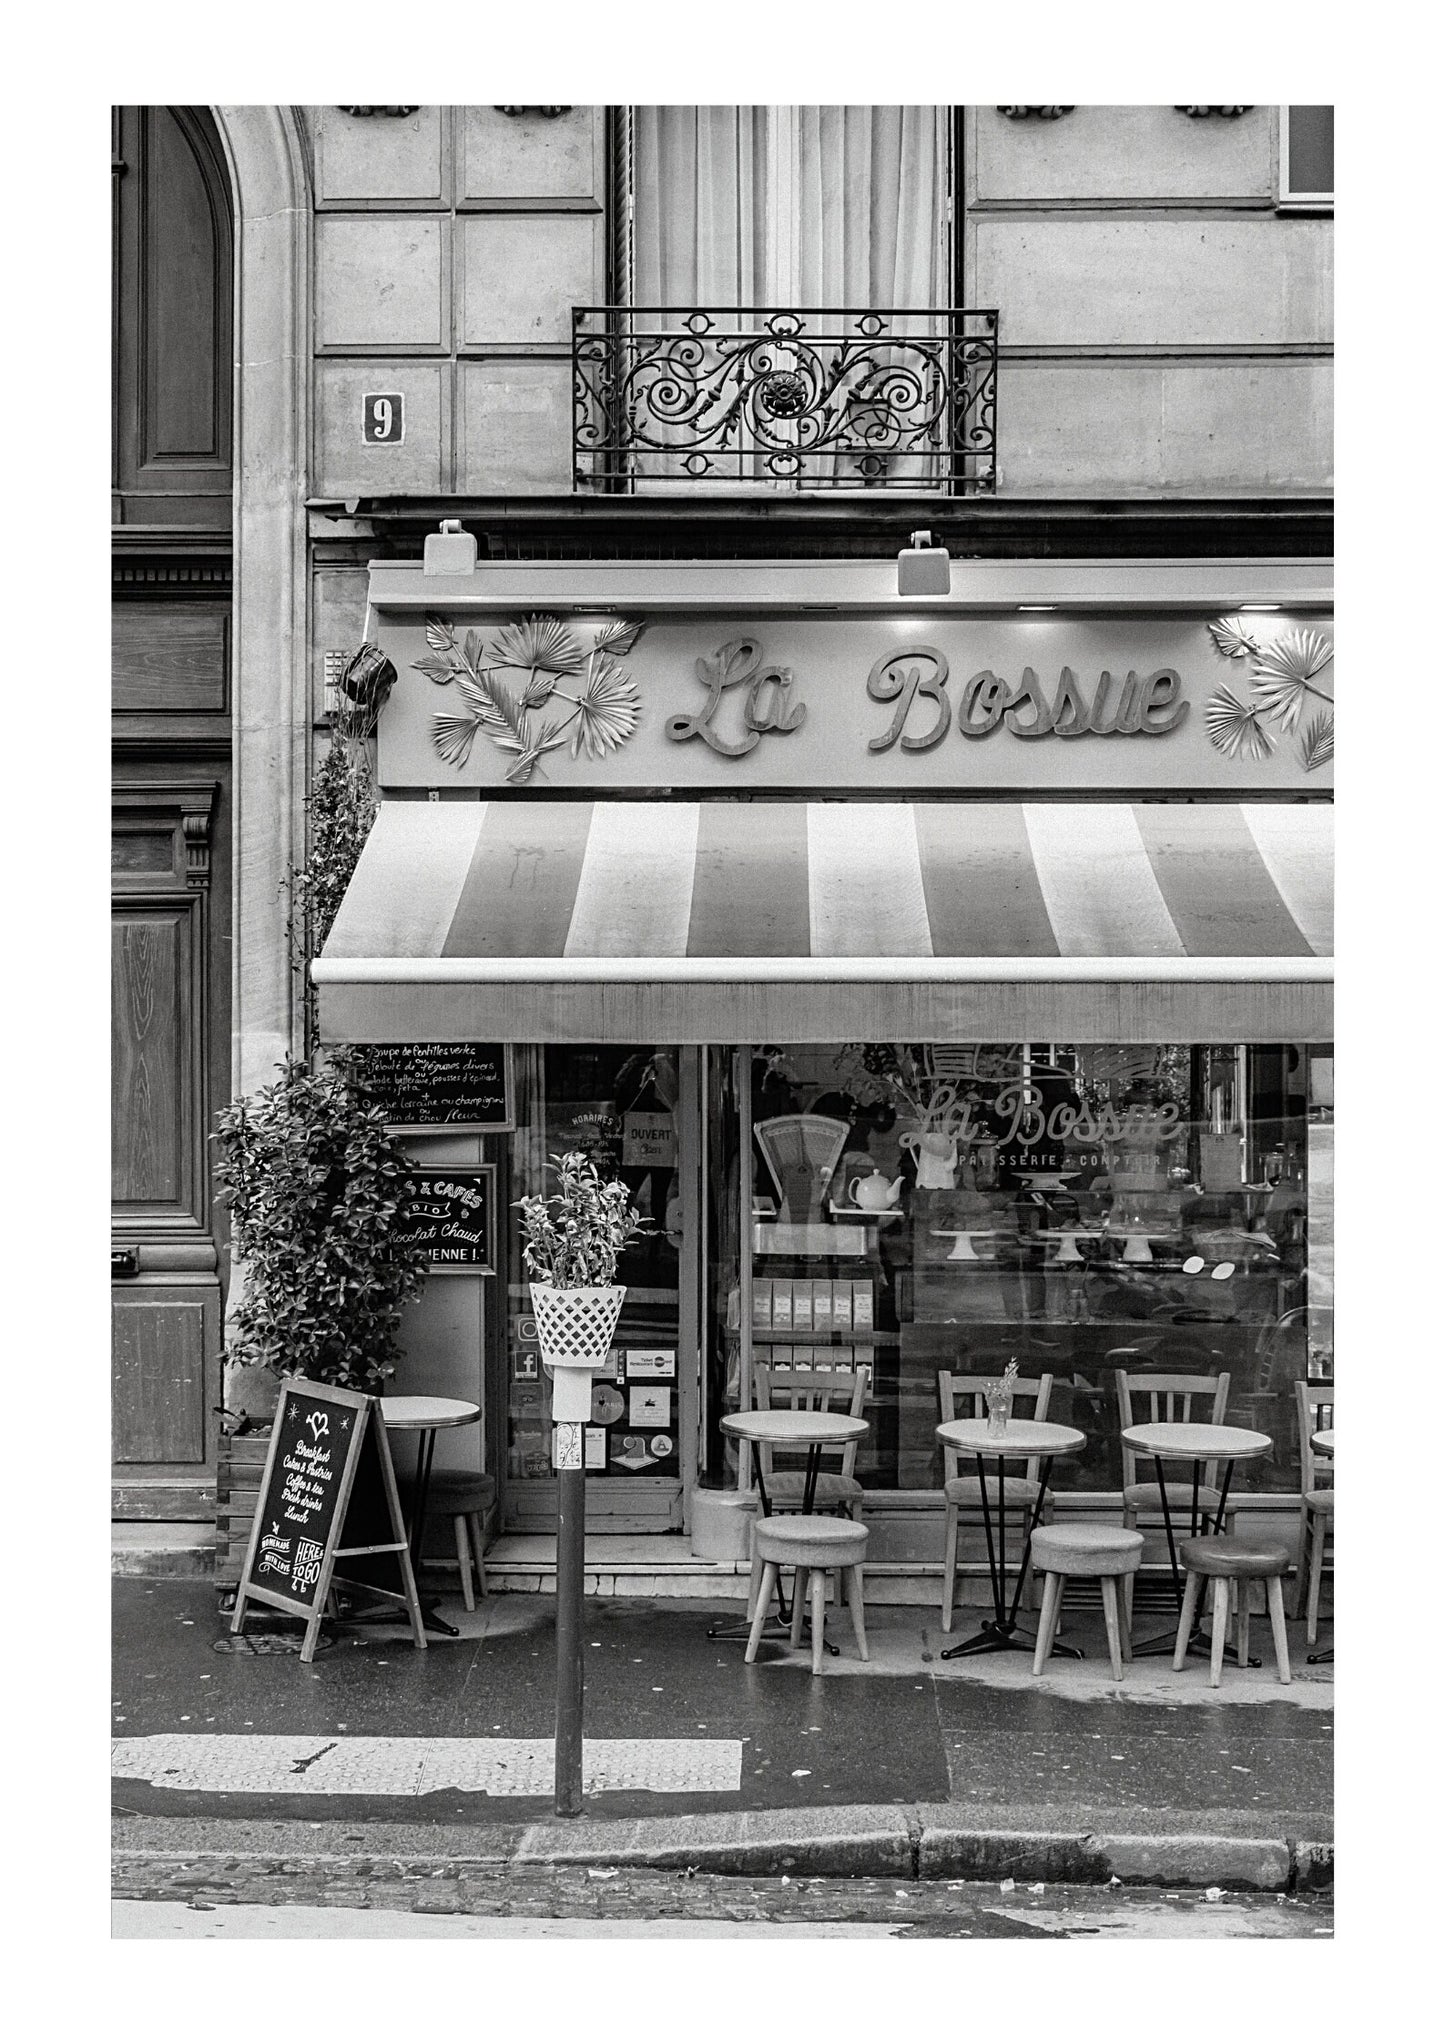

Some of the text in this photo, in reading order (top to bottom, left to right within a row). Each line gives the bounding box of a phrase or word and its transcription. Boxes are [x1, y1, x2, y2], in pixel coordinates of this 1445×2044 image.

[374, 399, 392, 438] 9
[664, 637, 1191, 757] La Bossue
[402, 1046, 412, 1056] de
[463, 1058, 495, 1070] divers
[899, 1084, 1188, 1148] La Bossue
[631, 1128, 672, 1140] OUVERT
[420, 1182, 431, 1195] &
[434, 1181, 482, 1209] CAFÉS
[412, 1204, 440, 1214] BIO
[389, 1221, 482, 1243] hocolat Chaud
[295, 1440, 331, 1465] Breakfast
[283, 1454, 333, 1481] Cakes & Pastries
[286, 1473, 325, 1496] Coffee & tea
[281, 1488, 323, 1511] Fresh drinks
[284, 1505, 309, 1524] Lunch
[261, 1538, 290, 1550] HOMEMADE
[295, 1541, 320, 1563] HERE
[265, 1553, 291, 1572] WITH LOVE
[292, 1562, 320, 1584] TO GO
